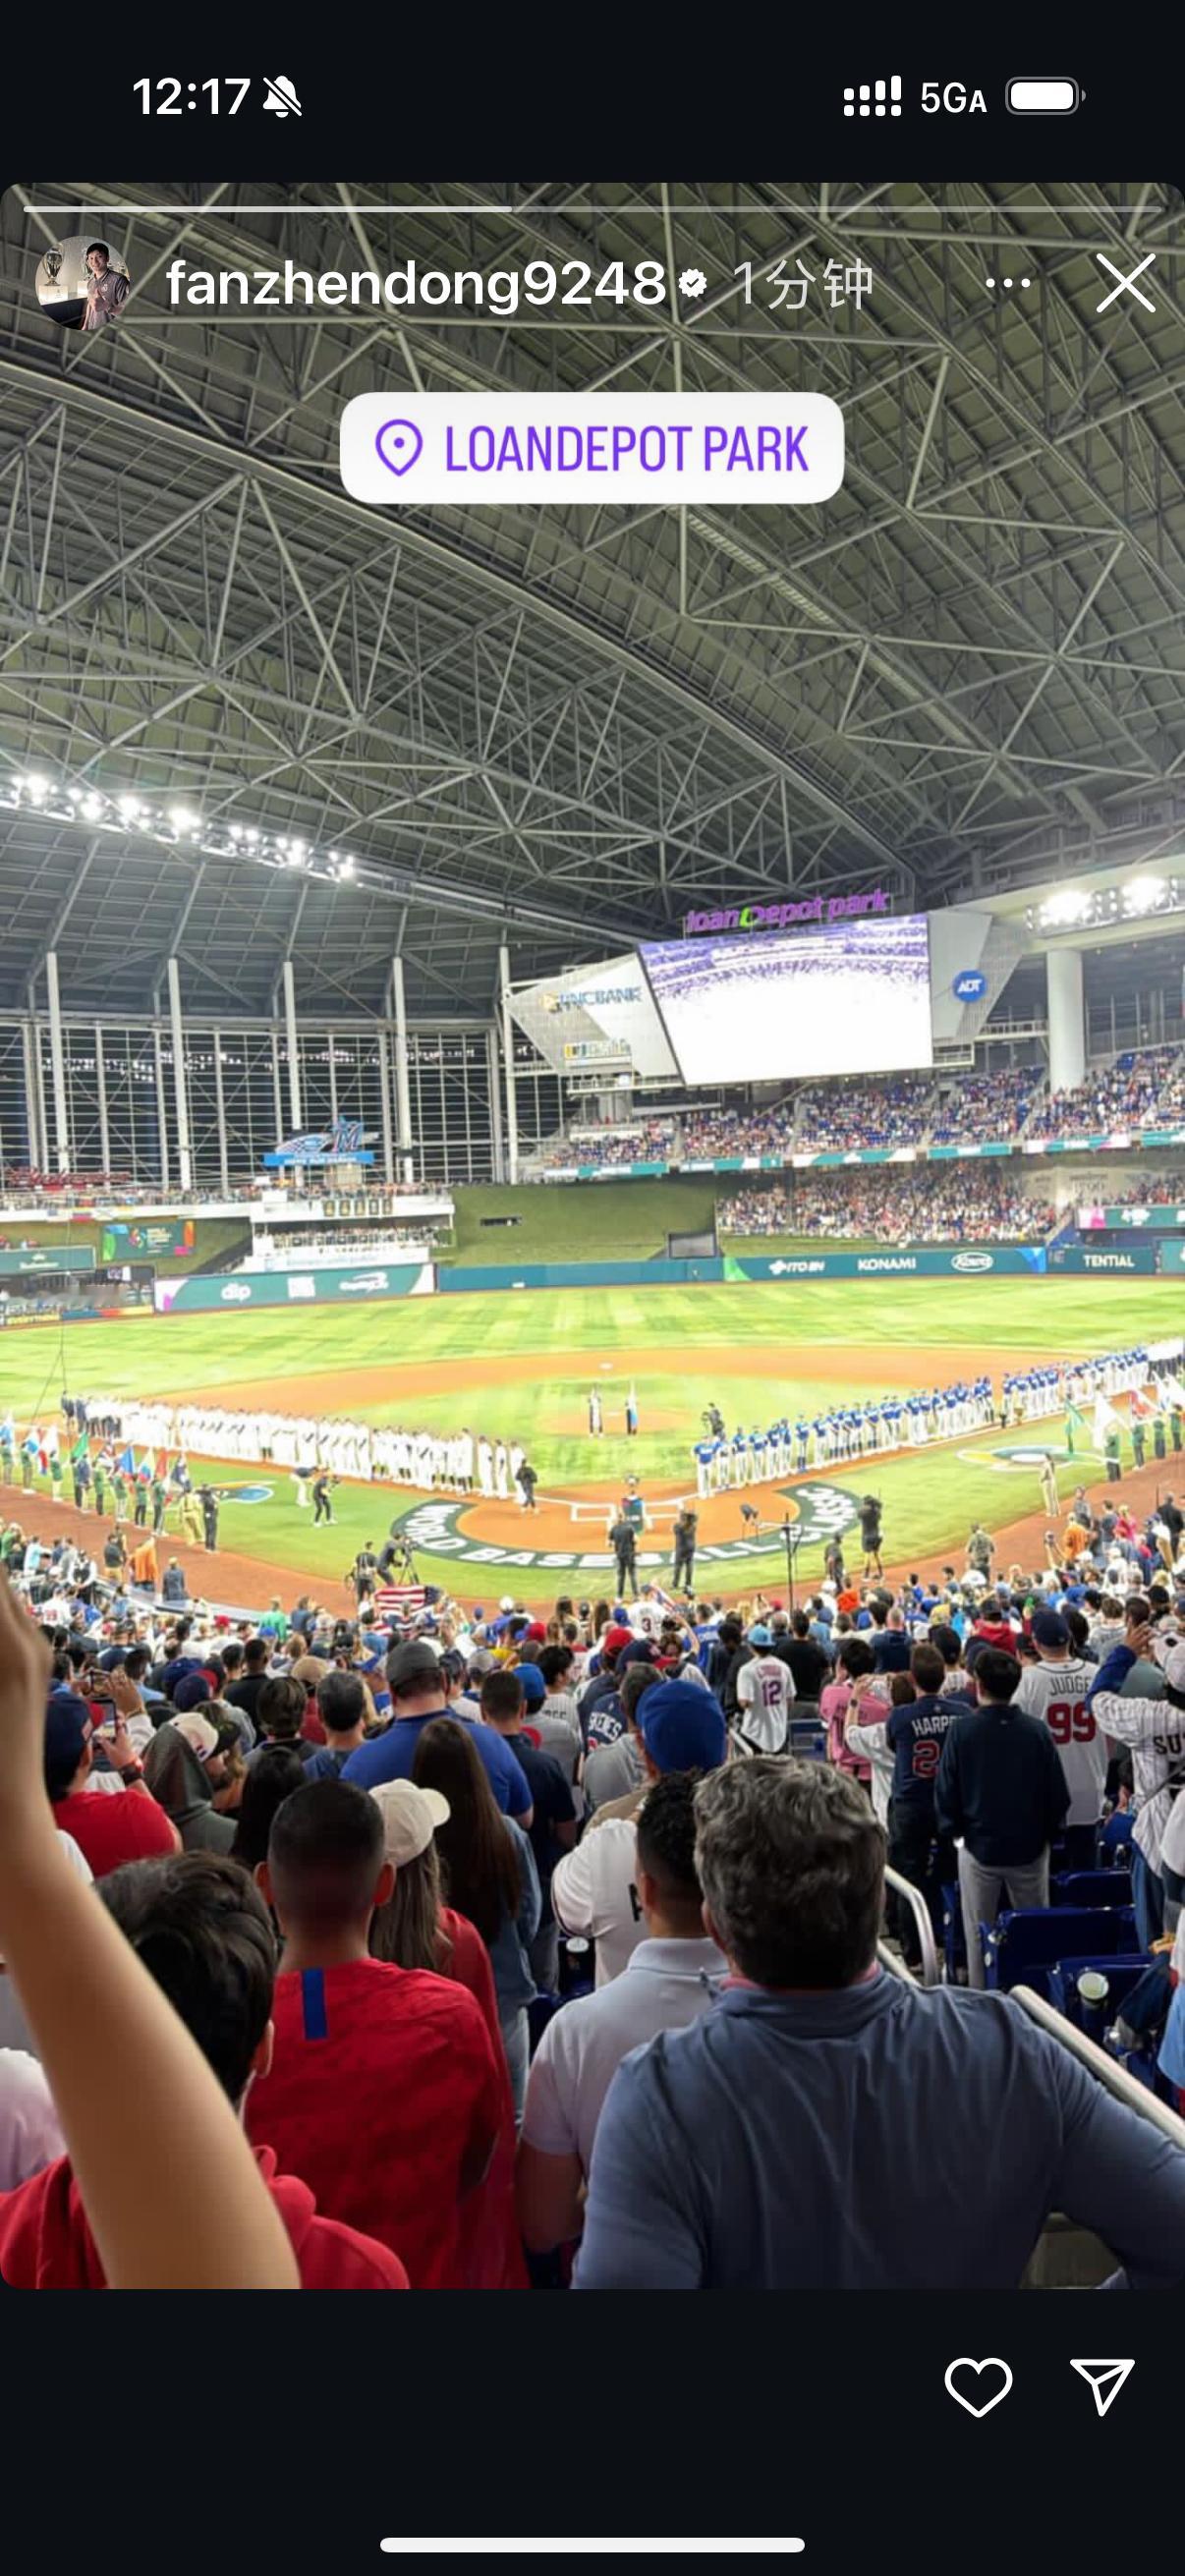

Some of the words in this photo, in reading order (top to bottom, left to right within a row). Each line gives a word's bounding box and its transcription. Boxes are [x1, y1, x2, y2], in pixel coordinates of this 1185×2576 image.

[827, 888, 889, 921] park
[956, 979, 984, 994] ADT
[857, 1257, 917, 1271] KONAMI
[1082, 1254, 1135, 1268] TENTIAL
[762, 1680, 782, 1708] 12
[1049, 1674, 1092, 1697] JUDGE
[911, 1713, 963, 1738] HARP
[1047, 1701, 1097, 1745] 99
[1153, 1732, 1185, 1756] SU
